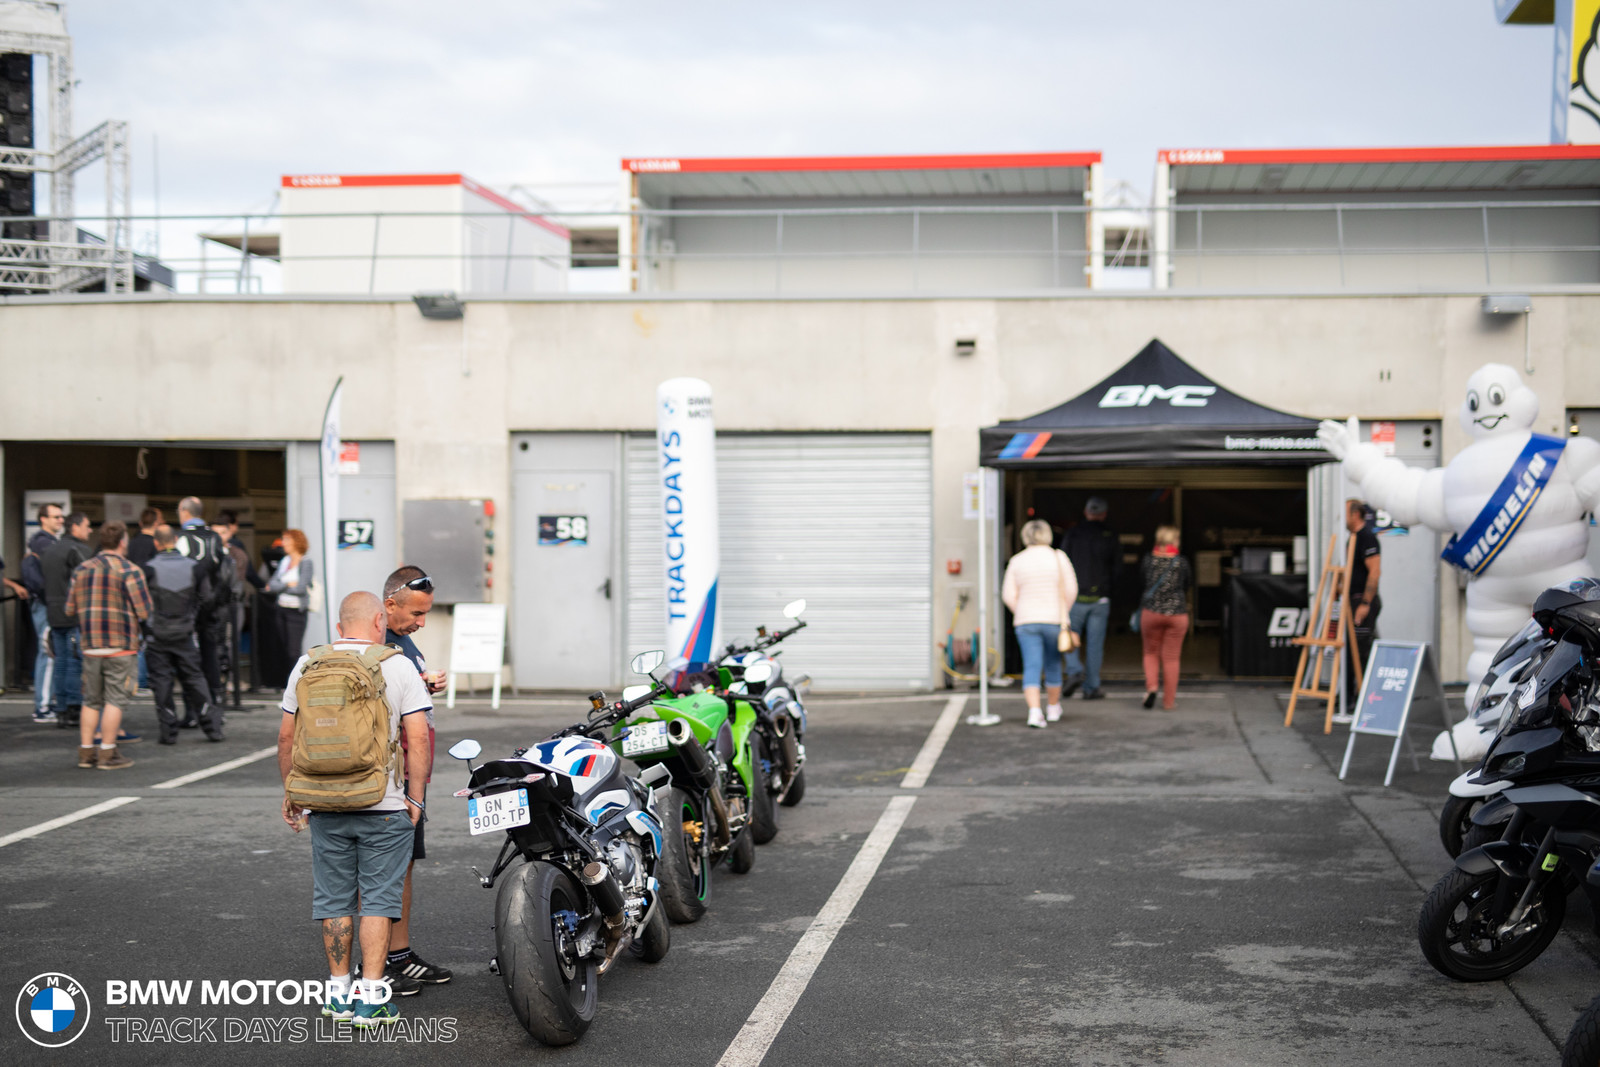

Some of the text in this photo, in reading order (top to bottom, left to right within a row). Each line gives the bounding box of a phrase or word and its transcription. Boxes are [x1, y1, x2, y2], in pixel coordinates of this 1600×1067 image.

[1097, 384, 1217, 408] BMC
[1463, 452, 1547, 569] MICHELIN
[344, 521, 373, 543] 57
[556, 516, 587, 539] 58
[662, 430, 686, 625] TRACKDAYS
[1377, 666, 1408, 679] STAND
[634, 726, 647, 737] DS
[485, 799, 502, 813] GN
[473, 807, 526, 830] 900-TP
